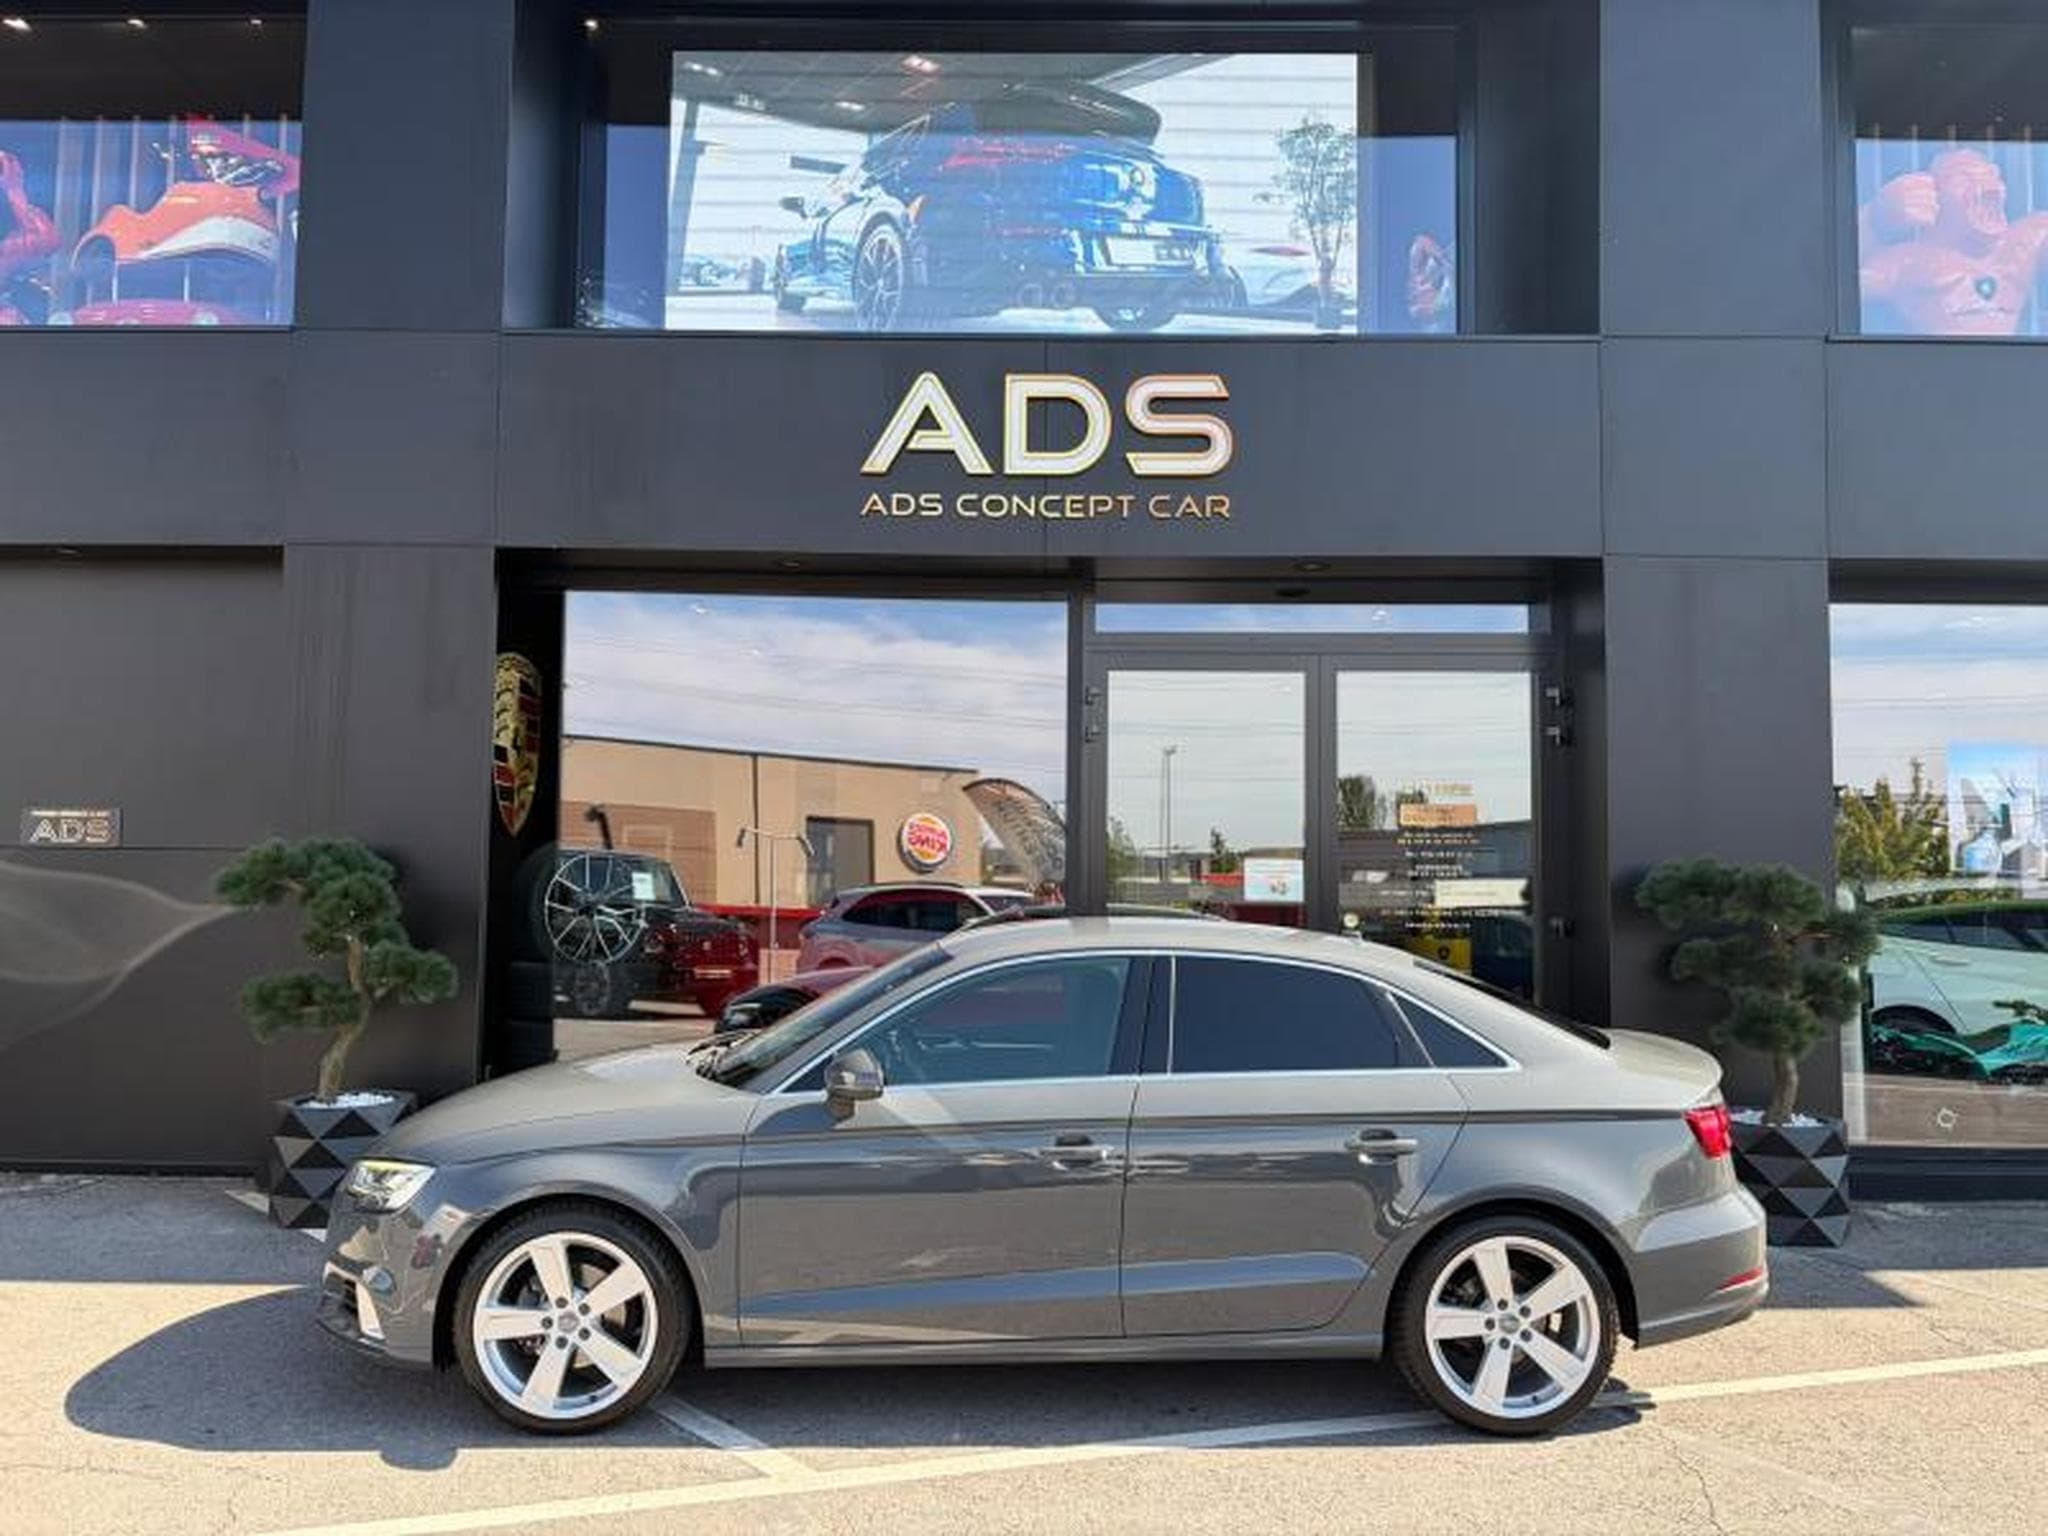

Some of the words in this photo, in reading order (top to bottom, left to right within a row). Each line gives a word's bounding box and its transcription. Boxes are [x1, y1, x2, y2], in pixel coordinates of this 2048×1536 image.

[860, 371, 1233, 476] ADS
[860, 493, 943, 517] ADS
[956, 493, 1136, 518] CONCEPT
[1148, 494, 1231, 519] CAR
[29, 818, 111, 842] ADS
